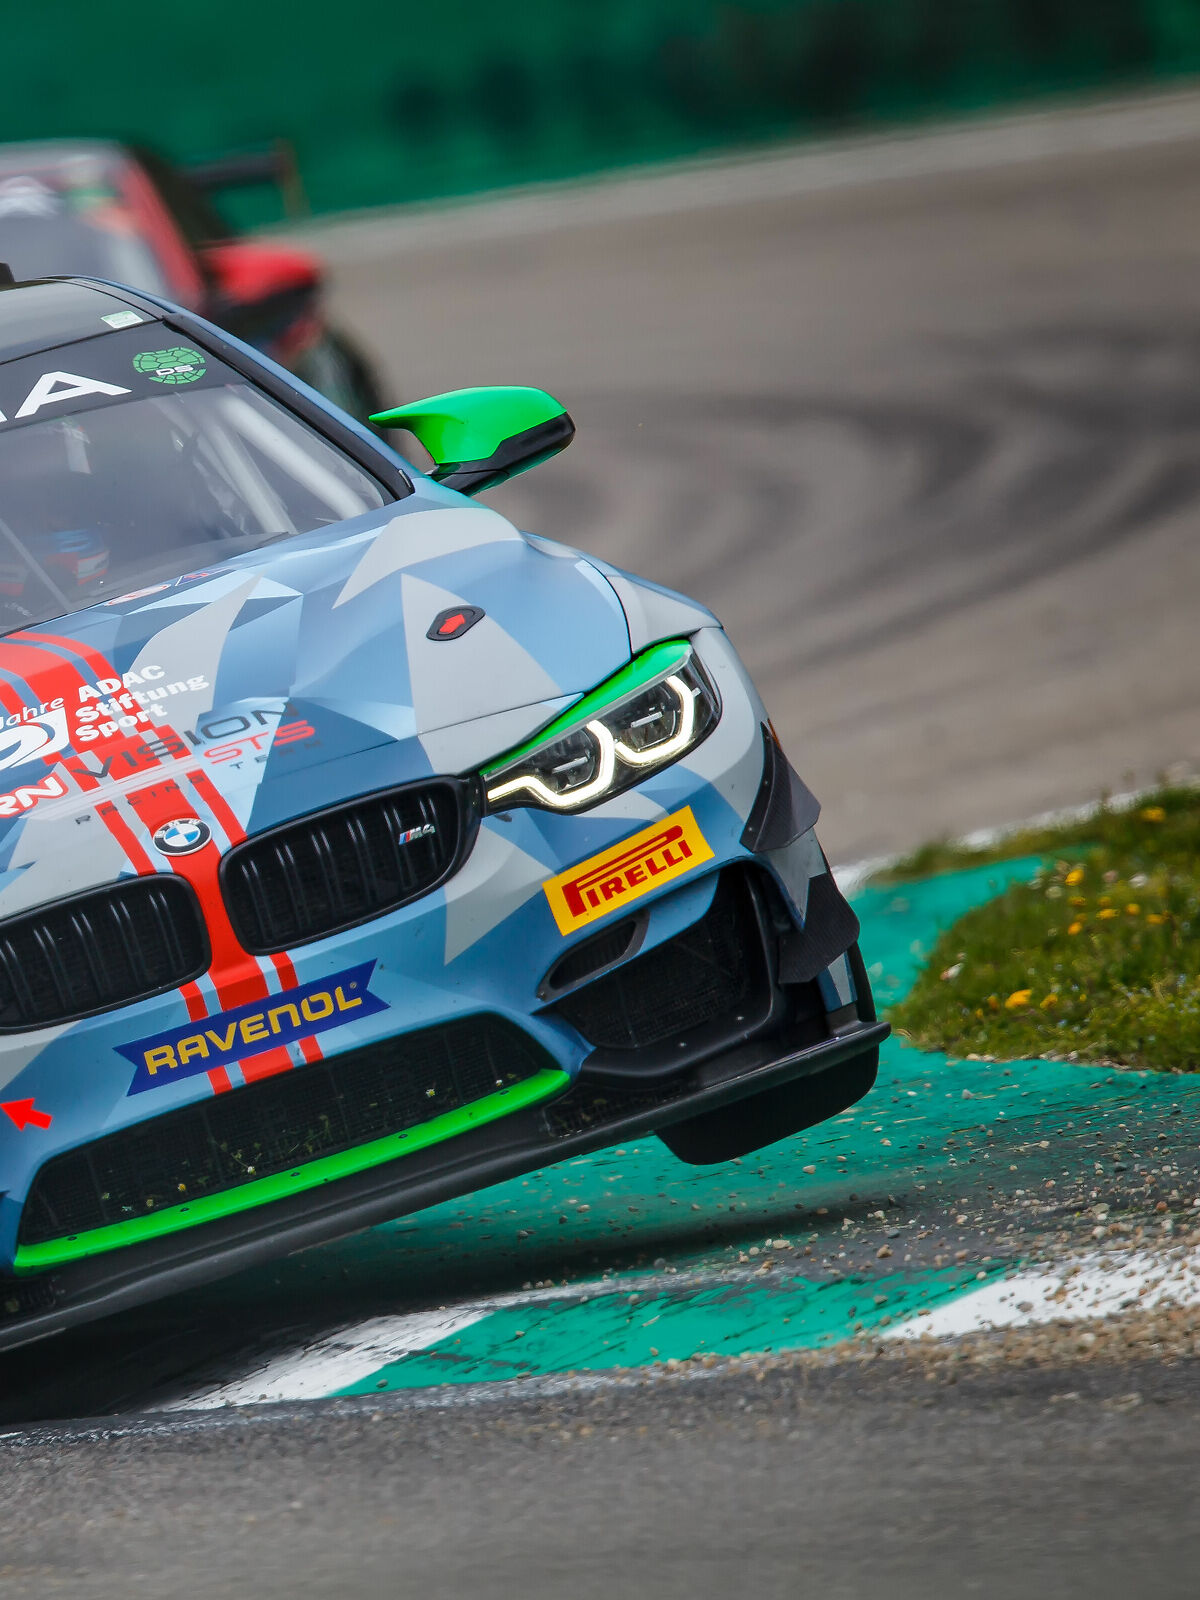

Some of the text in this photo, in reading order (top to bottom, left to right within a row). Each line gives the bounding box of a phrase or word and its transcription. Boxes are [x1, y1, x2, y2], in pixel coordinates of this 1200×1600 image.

[155, 363, 194, 376] DS
[75, 674, 210, 723] Stiftung
[78, 665, 166, 703] ADAC
[71, 702, 299, 779] VISION
[203, 720, 316, 764] STS
[75, 702, 168, 743] Sport
[561, 825, 693, 918] PIRELLI
[143, 986, 363, 1076] RAVENOL
